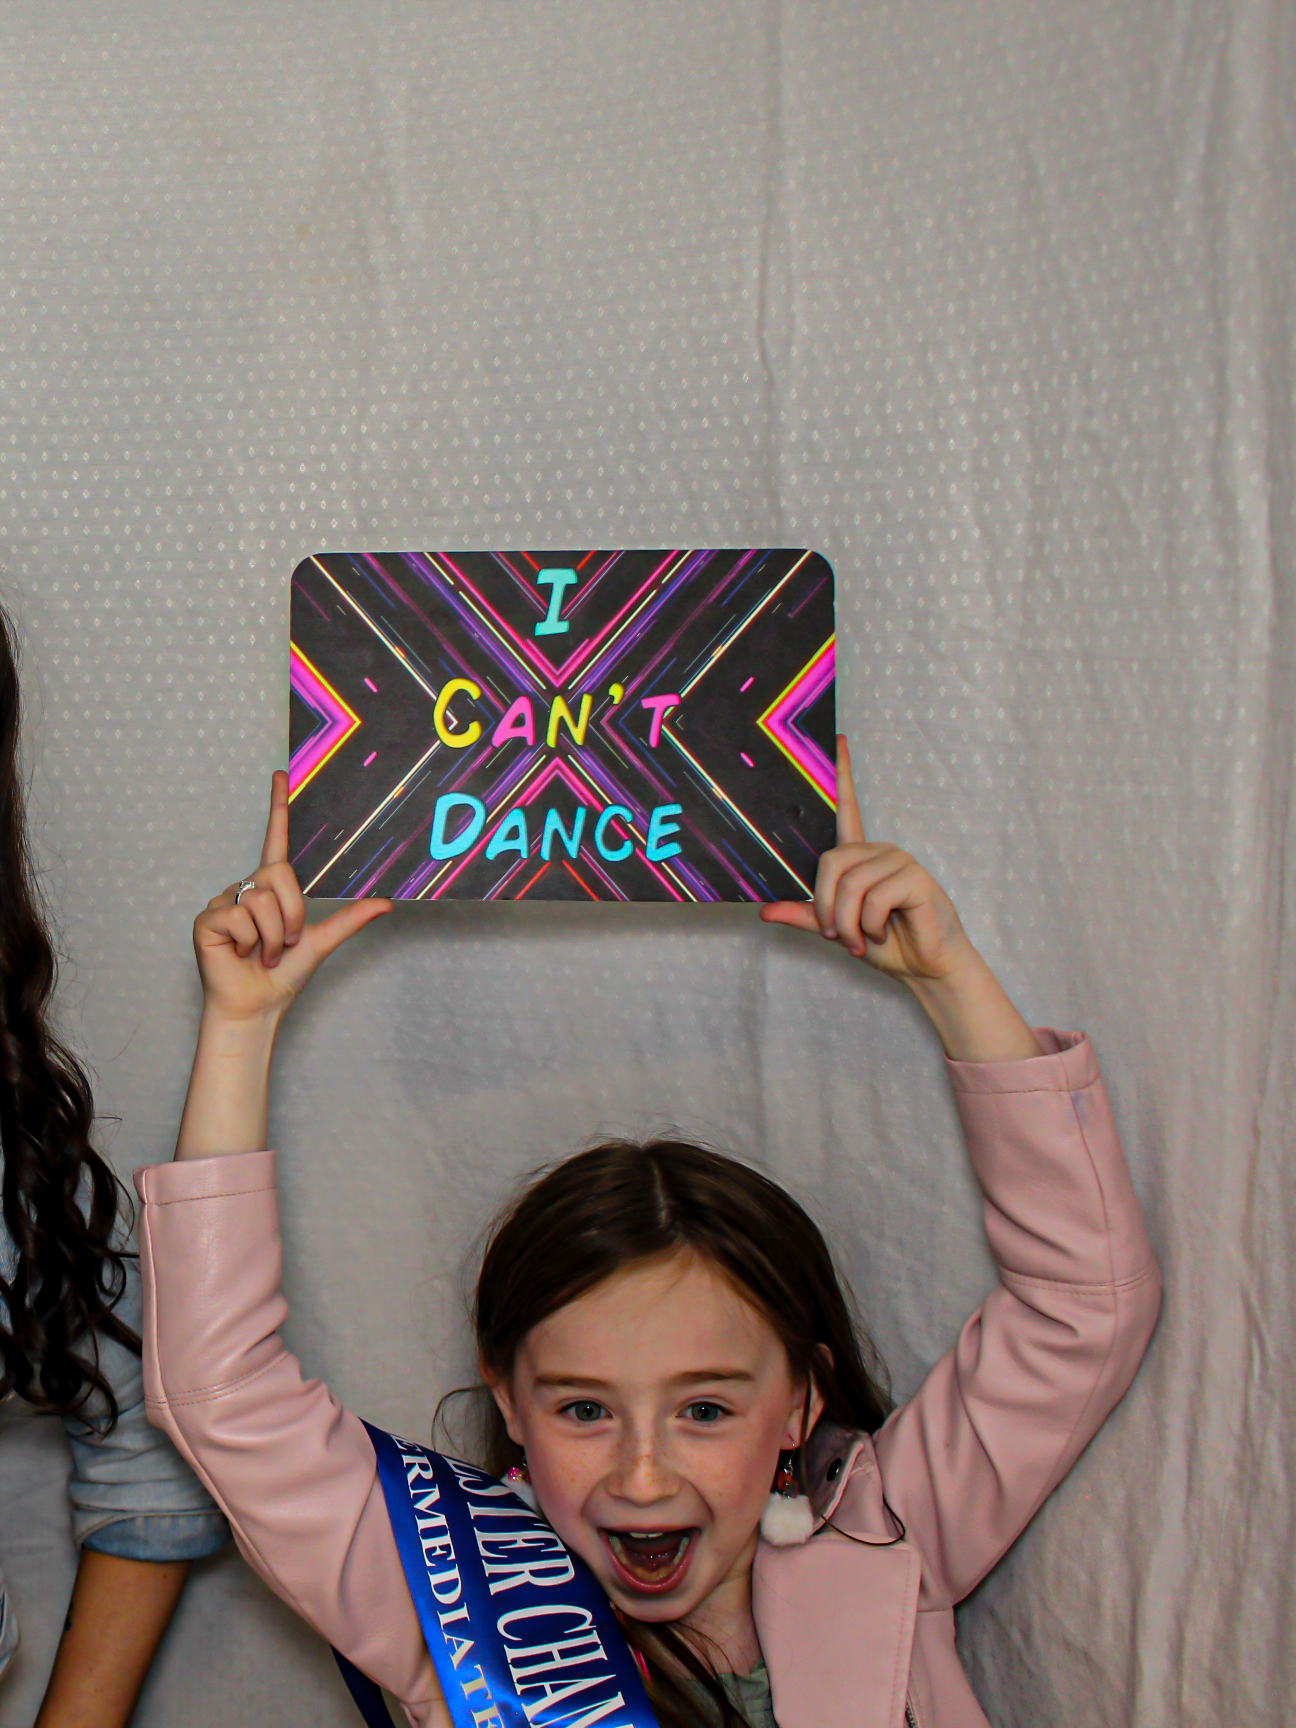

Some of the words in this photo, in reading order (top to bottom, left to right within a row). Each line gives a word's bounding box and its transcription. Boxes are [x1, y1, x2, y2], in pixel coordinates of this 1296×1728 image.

[534, 567, 578, 637] I
[433, 677, 682, 749] CAN'T
[429, 792, 682, 862] DANCE
